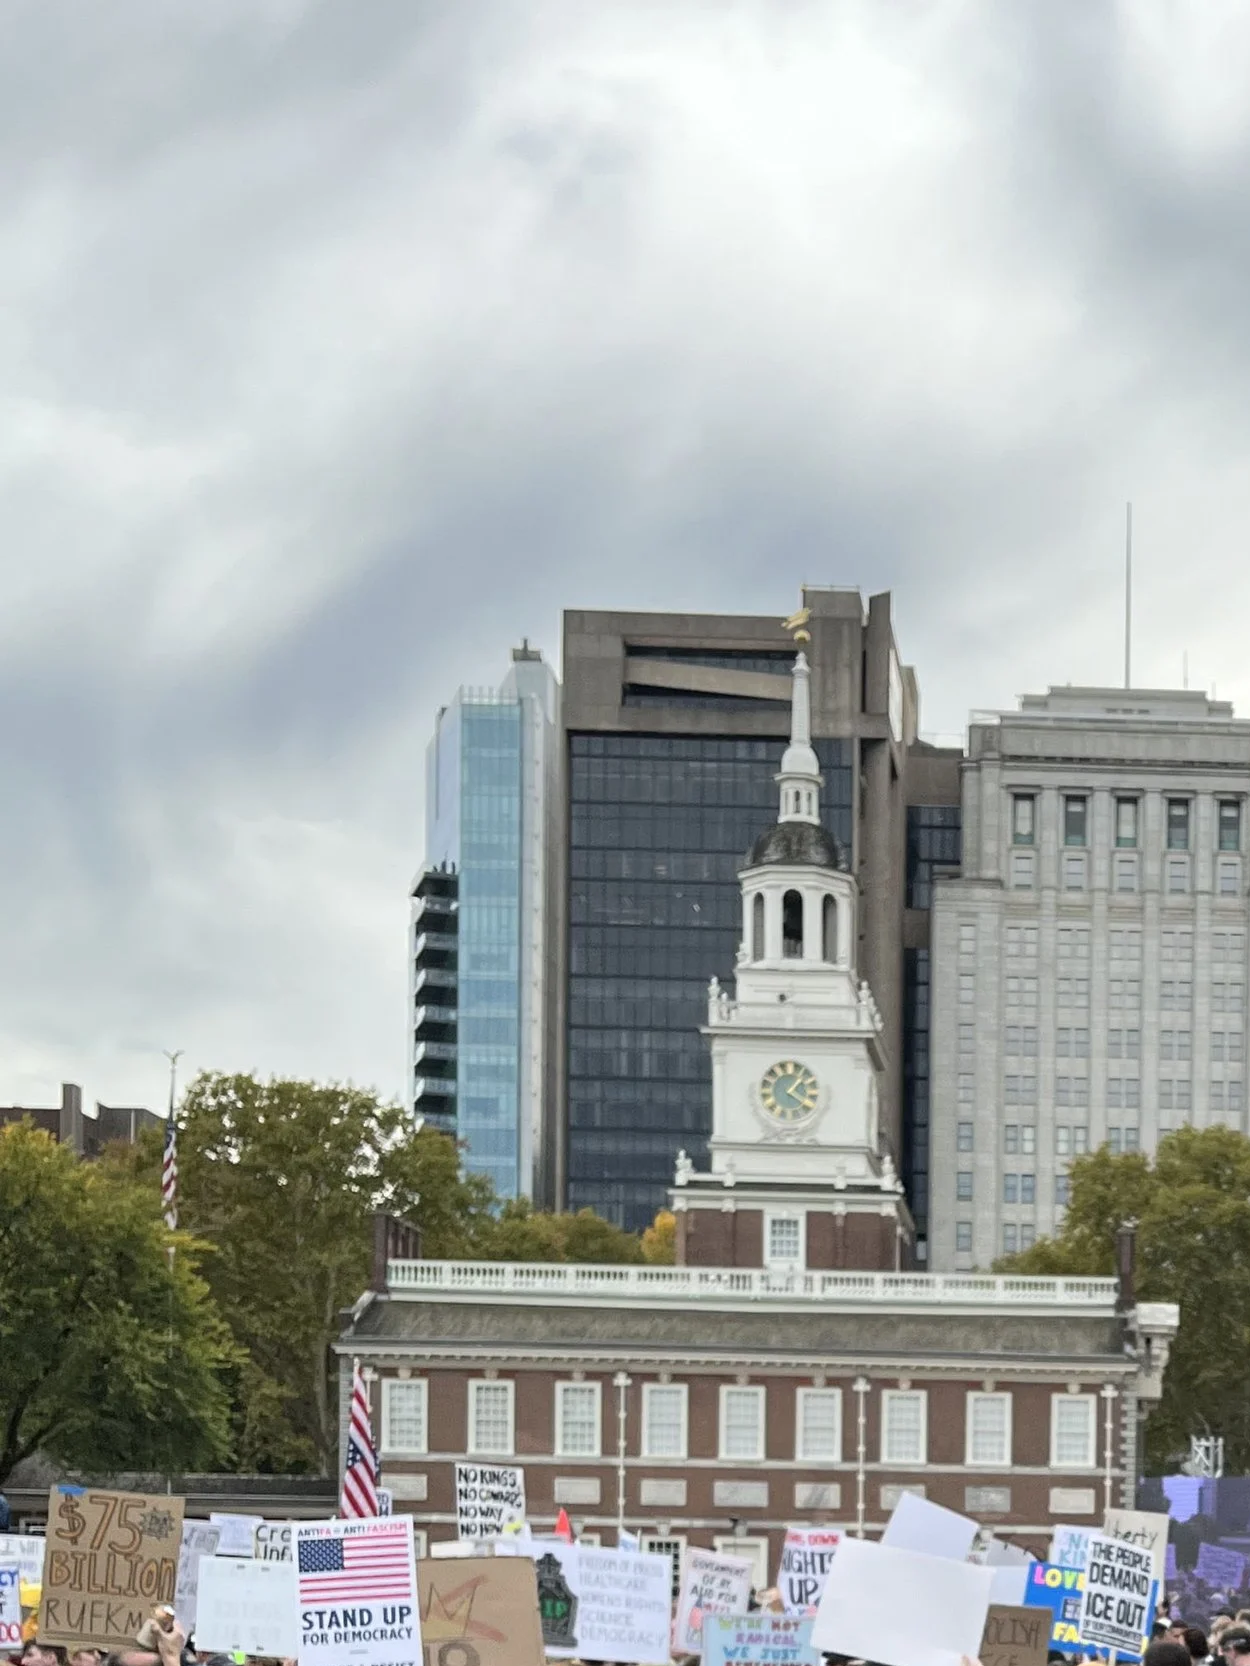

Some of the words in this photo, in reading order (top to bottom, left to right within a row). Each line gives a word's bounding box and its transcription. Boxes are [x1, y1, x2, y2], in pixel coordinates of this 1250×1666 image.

[459, 1468, 477, 1484] NO
[480, 1469, 517, 1487] KINGS
[459, 1488, 477, 1500] NO
[459, 1506, 477, 1519] NO
[479, 1506, 503, 1521] WAY
[461, 1523, 477, 1536] NO
[1092, 1541, 1114, 1562] THE
[1116, 1546, 1152, 1573] PEOPLE
[1088, 1561, 1149, 1597] DEMAND
[302, 1607, 373, 1631] STAND
[383, 1605, 412, 1626] UP
[1085, 1591, 1114, 1621] ICE
[1116, 1598, 1146, 1630] OUT
[772, 1620, 800, 1632] NOT
[984, 1616, 1041, 1651] OLISH
[303, 1632, 329, 1646] FOR
[334, 1627, 413, 1644] DEMOCRACY
[580, 1625, 667, 1648] DEMOCRACY
[722, 1646, 750, 1659] WE
[760, 1647, 800, 1660] JUST
